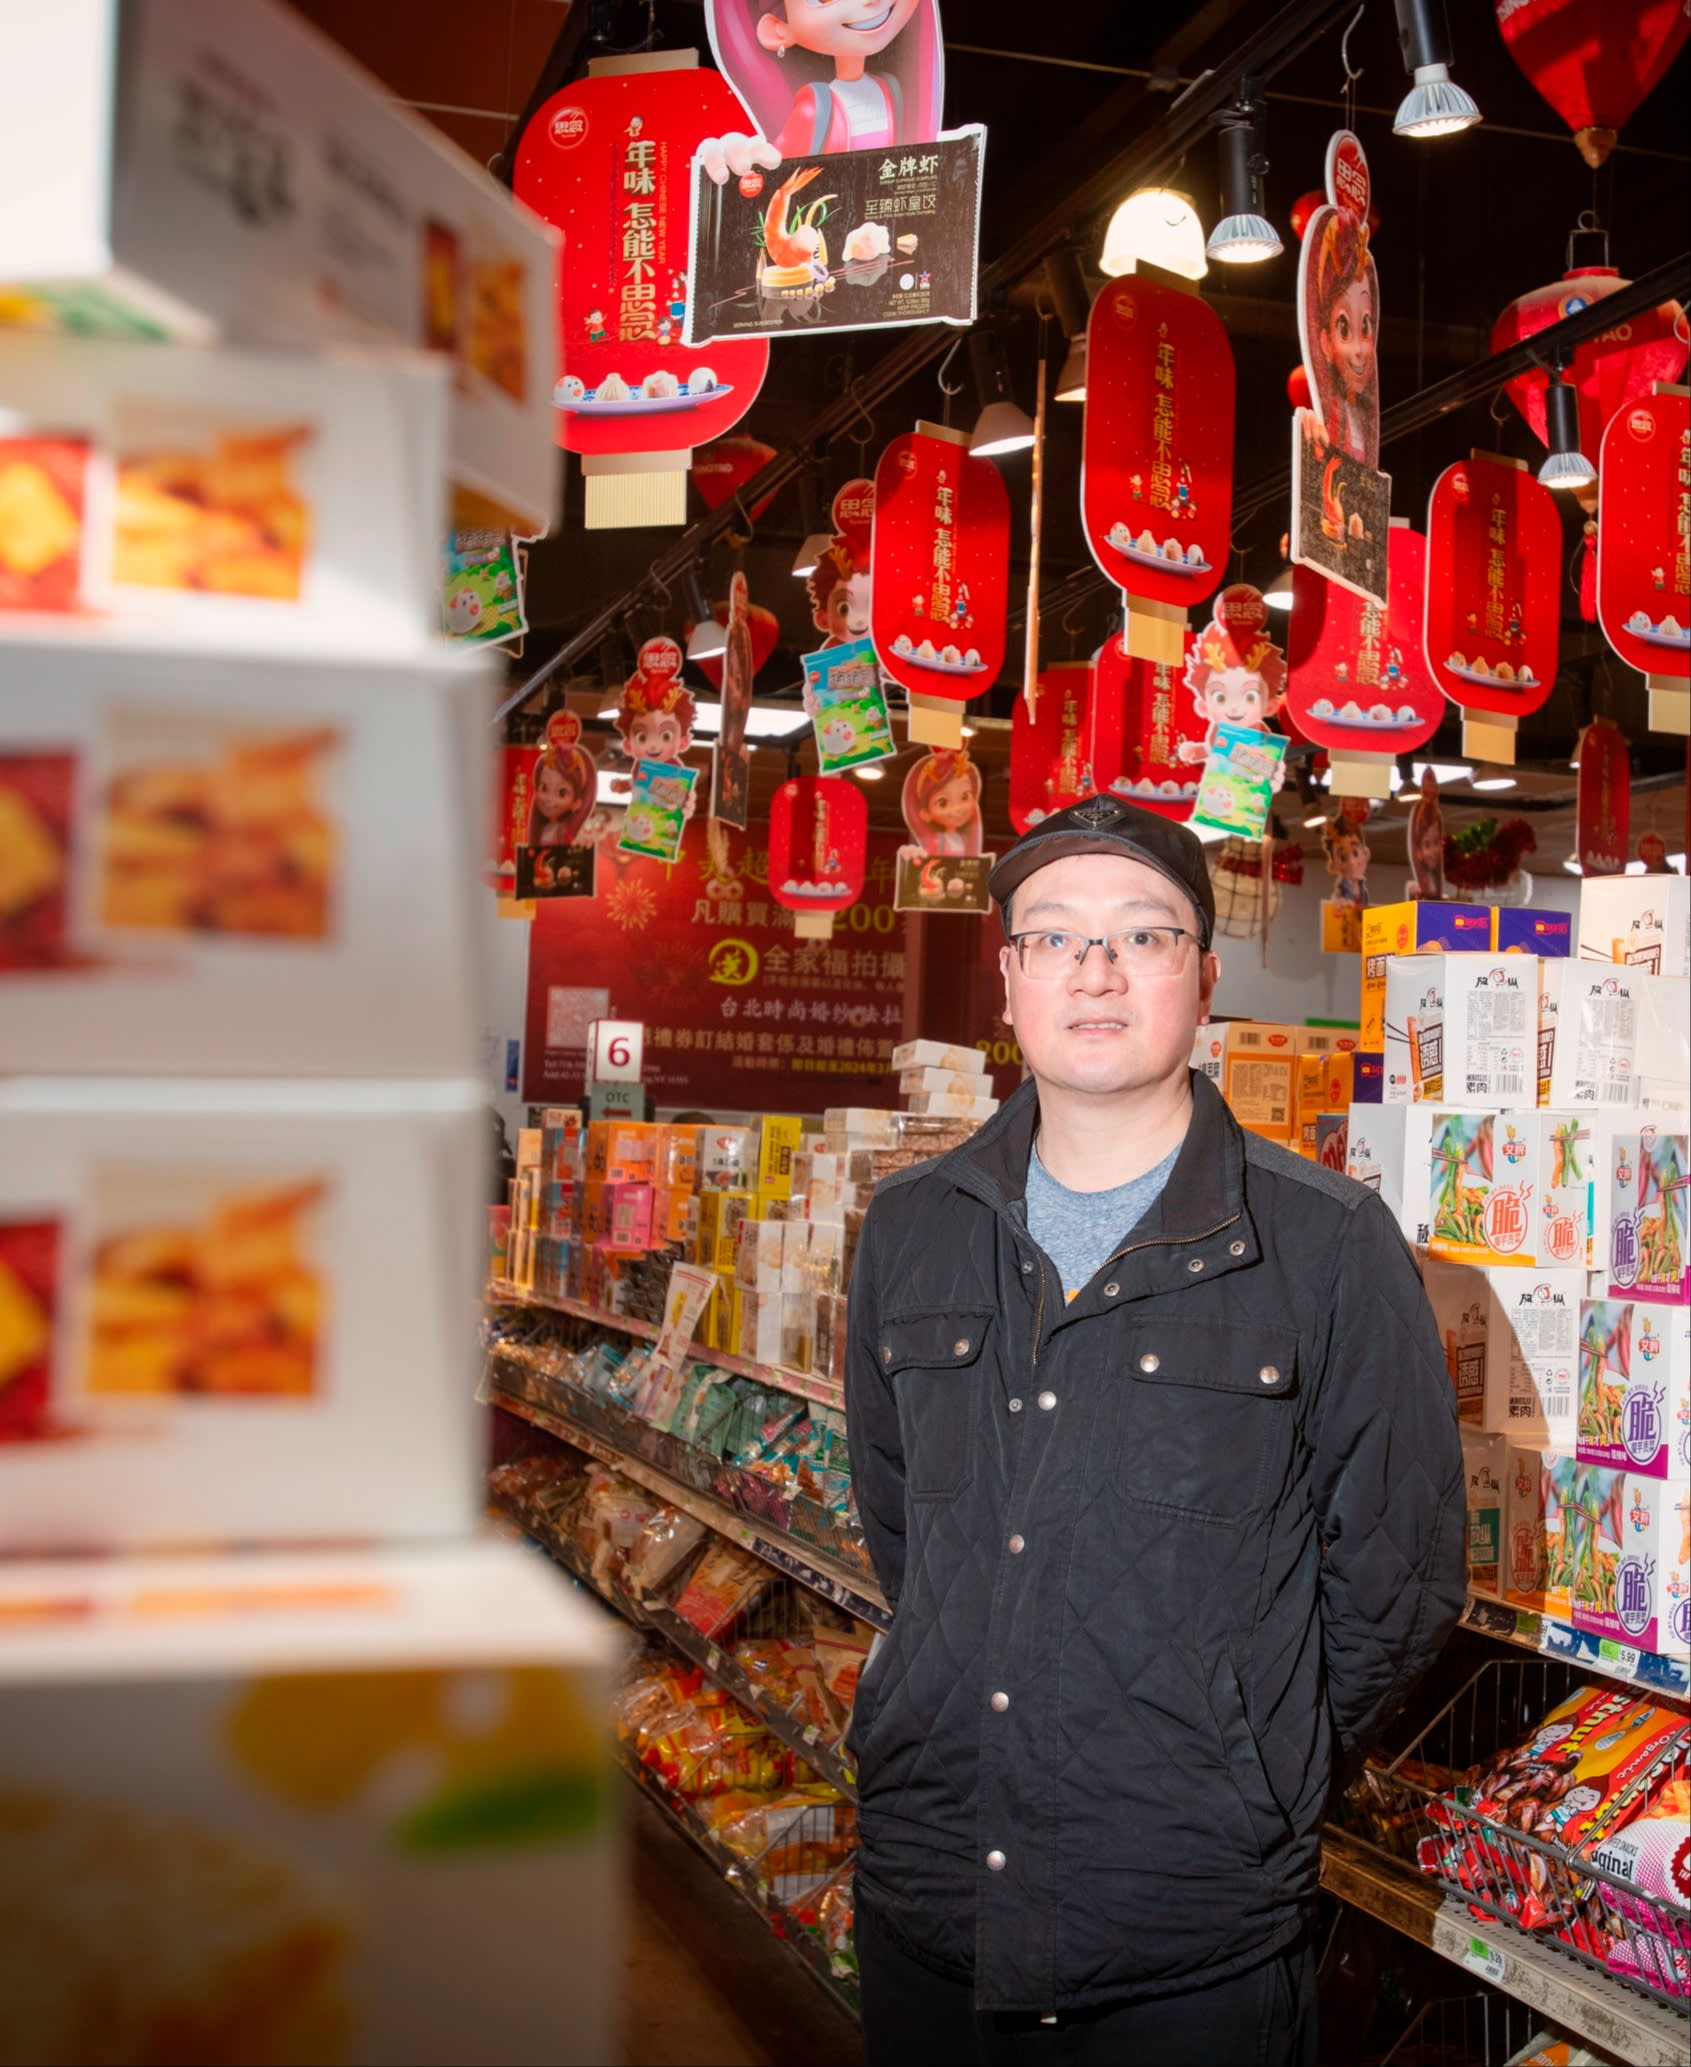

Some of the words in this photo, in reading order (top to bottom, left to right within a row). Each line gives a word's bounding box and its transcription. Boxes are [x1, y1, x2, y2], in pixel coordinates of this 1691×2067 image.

[879, 155, 938, 180] 金牌虾
[608, 1037, 631, 1067] 6
[606, 1092, 630, 1103] OTC
[1490, 1194, 1523, 1236] 脆
[1552, 1221, 1574, 1249] 脆
[1615, 1225, 1636, 1267] 脆
[1628, 1396, 1656, 1442] 脆
[1621, 1569, 1648, 1612] 脆
